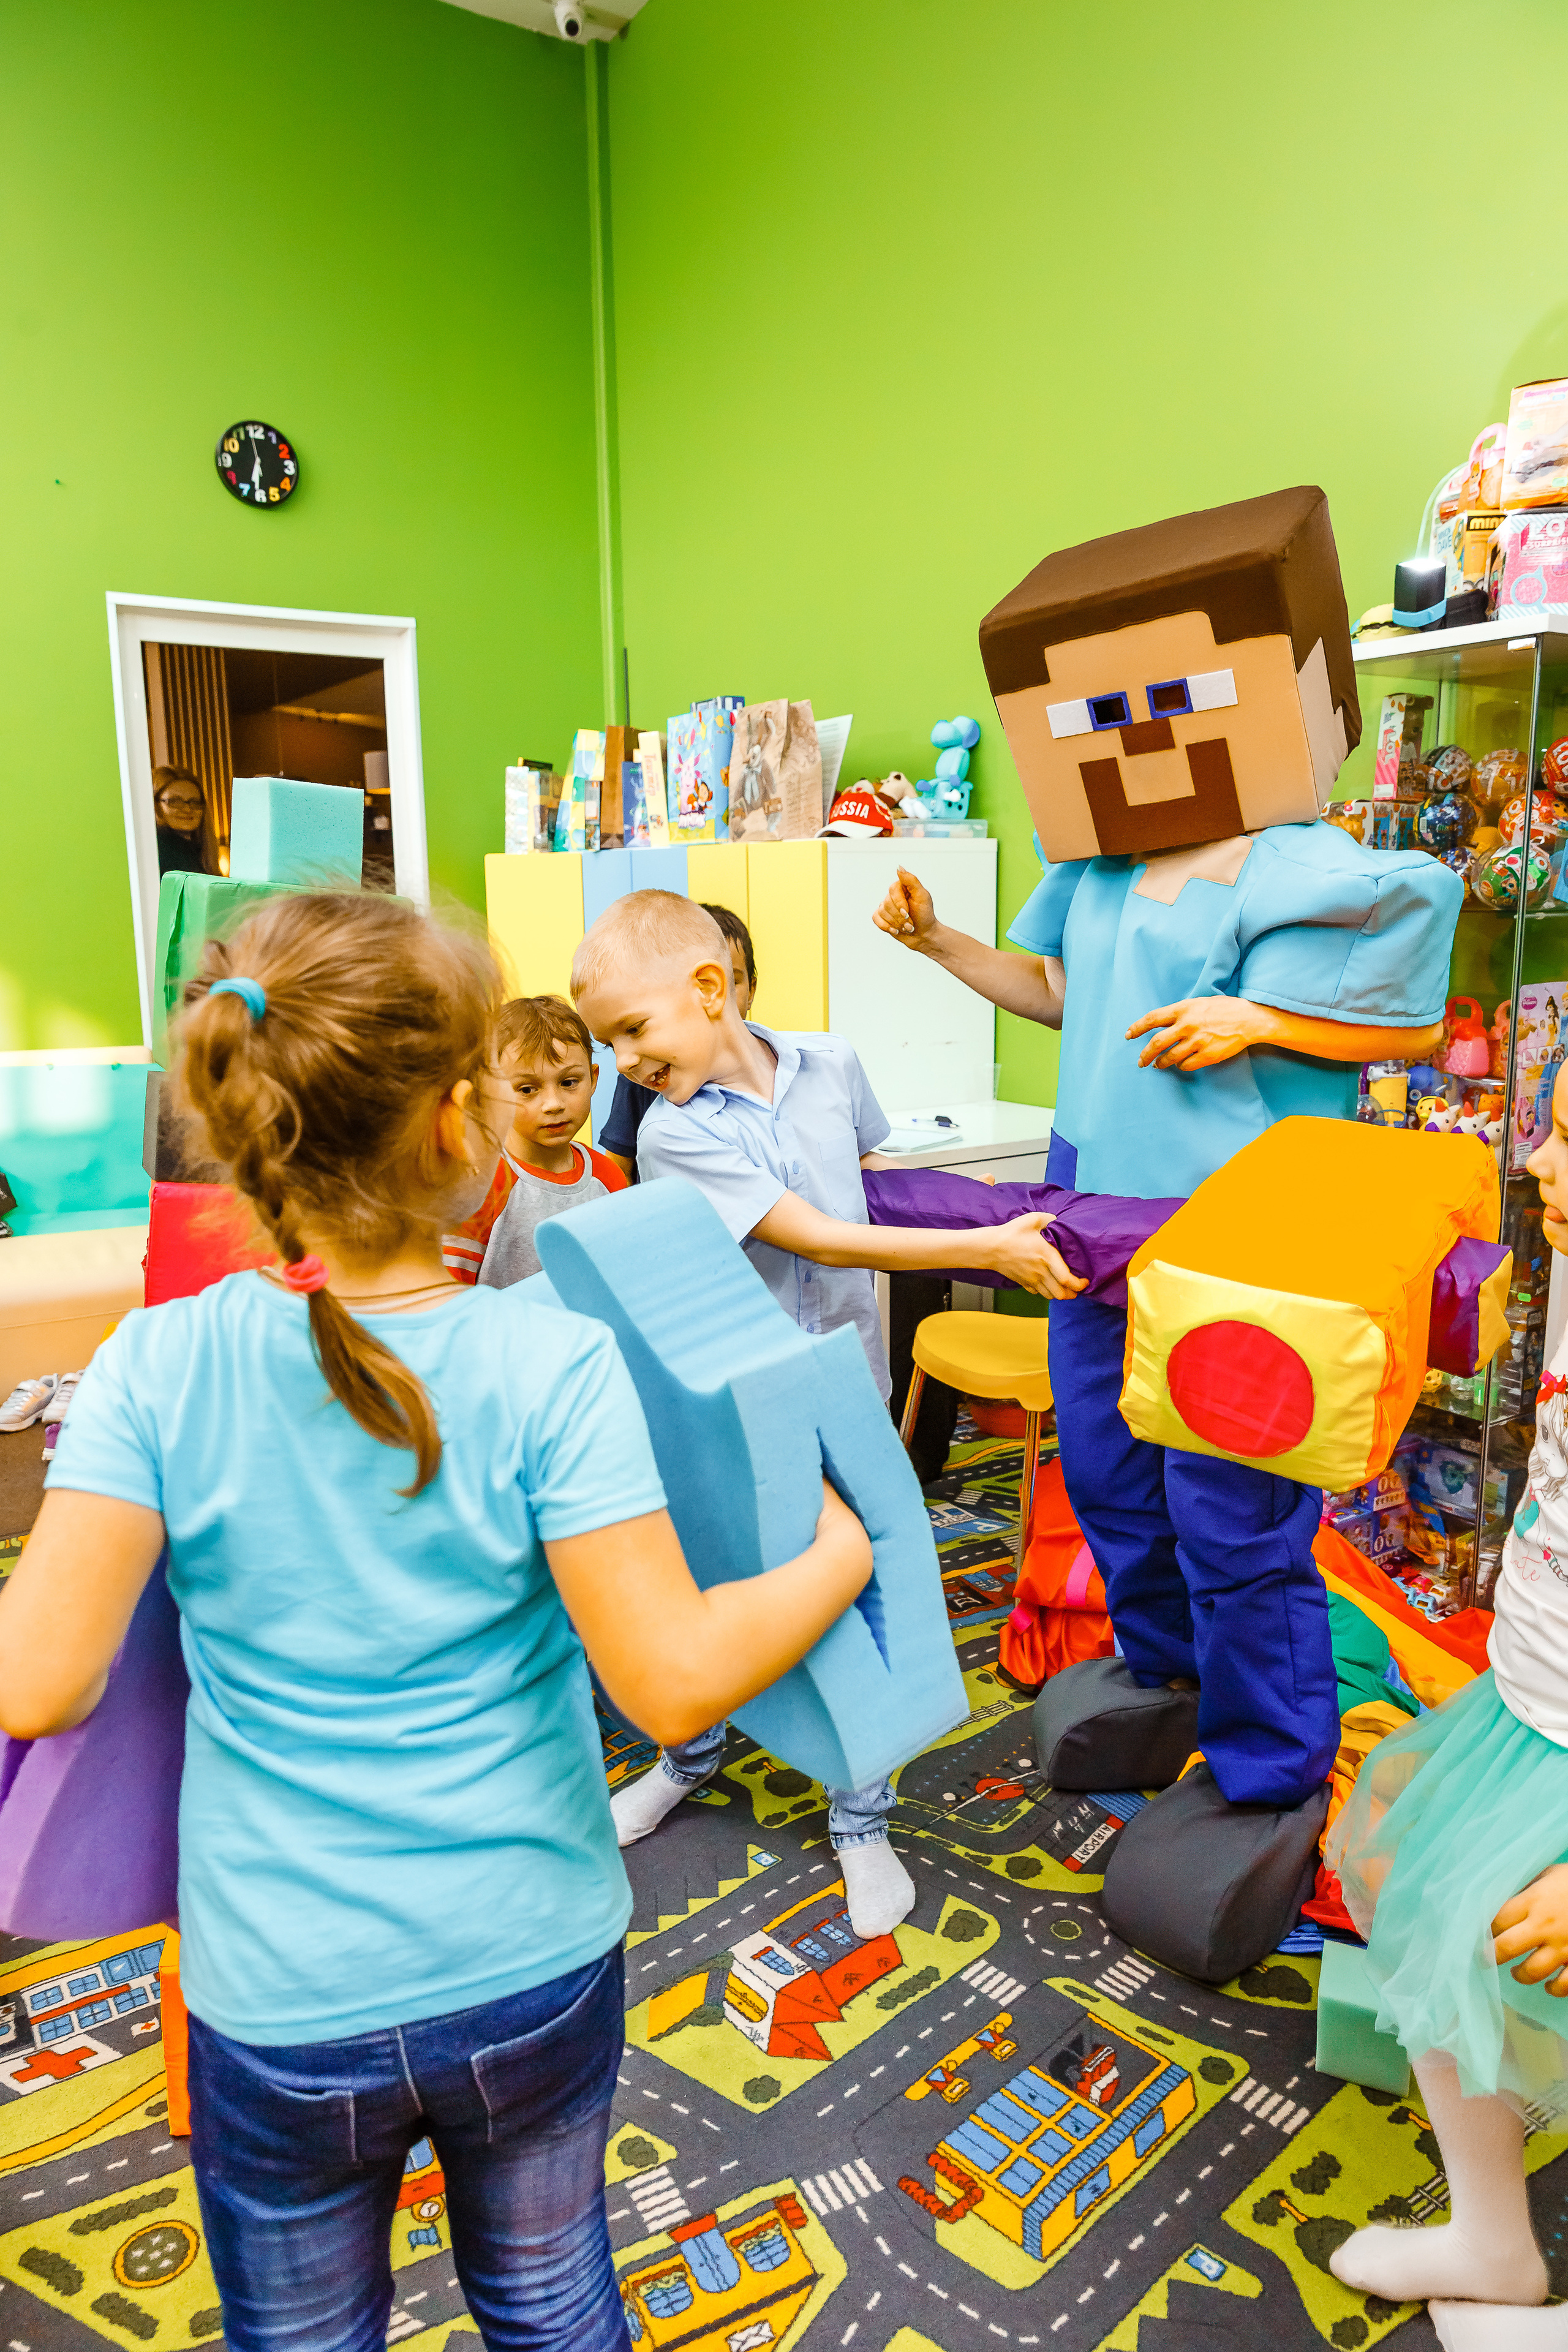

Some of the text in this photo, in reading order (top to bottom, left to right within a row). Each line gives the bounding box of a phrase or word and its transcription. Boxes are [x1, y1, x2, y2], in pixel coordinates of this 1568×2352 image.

[246, 424, 265, 440] 12
[268, 431, 277, 444] 1
[279, 443, 290, 459] 2
[284, 459, 295, 475] 3
[239, 483, 251, 496] 7
[280, 477, 291, 492] 4
[1529, 517, 1568, 540] LO
[831, 801, 869, 819] USSIA
[1075, 1824, 1112, 1861] AIRPORT
[1198, 2252, 1219, 2275] P
